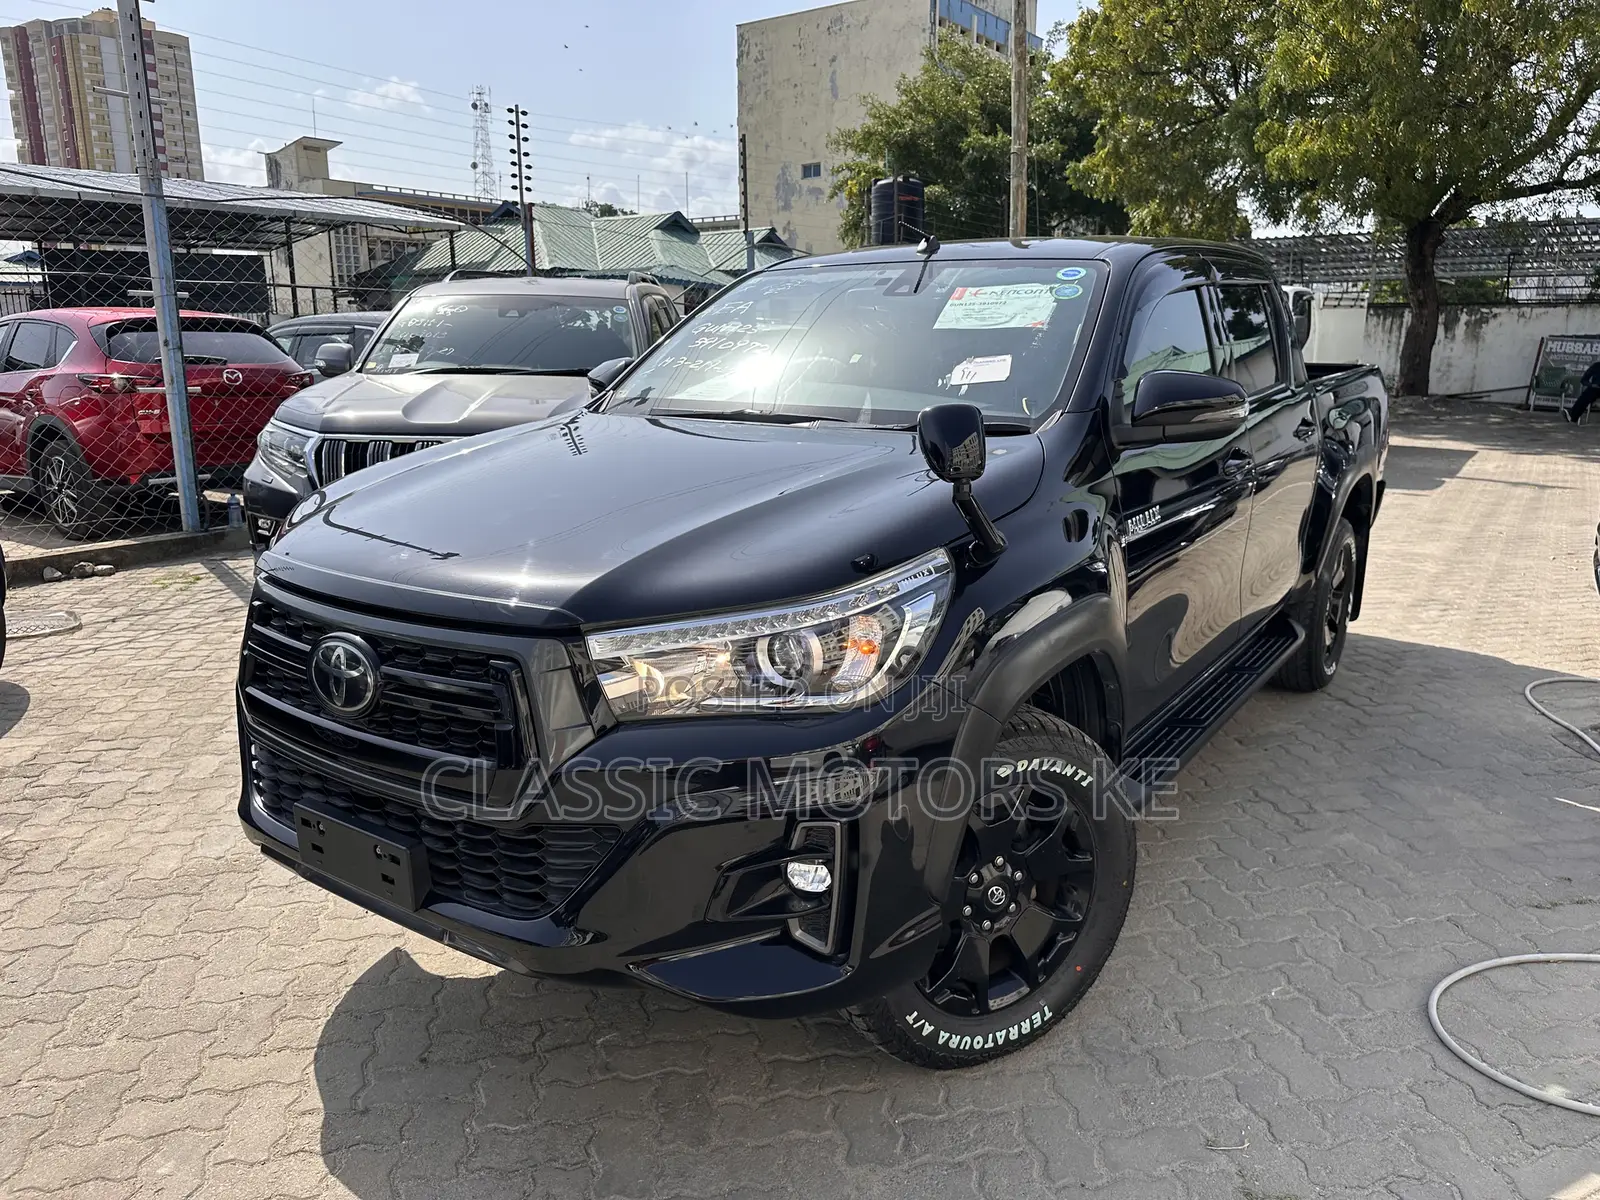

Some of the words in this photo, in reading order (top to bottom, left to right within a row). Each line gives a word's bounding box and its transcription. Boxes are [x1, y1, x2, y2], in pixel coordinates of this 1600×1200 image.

[1016, 759, 1094, 787] DAVANTI
[905, 1010, 935, 1037] A/T
[937, 1005, 1053, 1050] TERRATOURA
